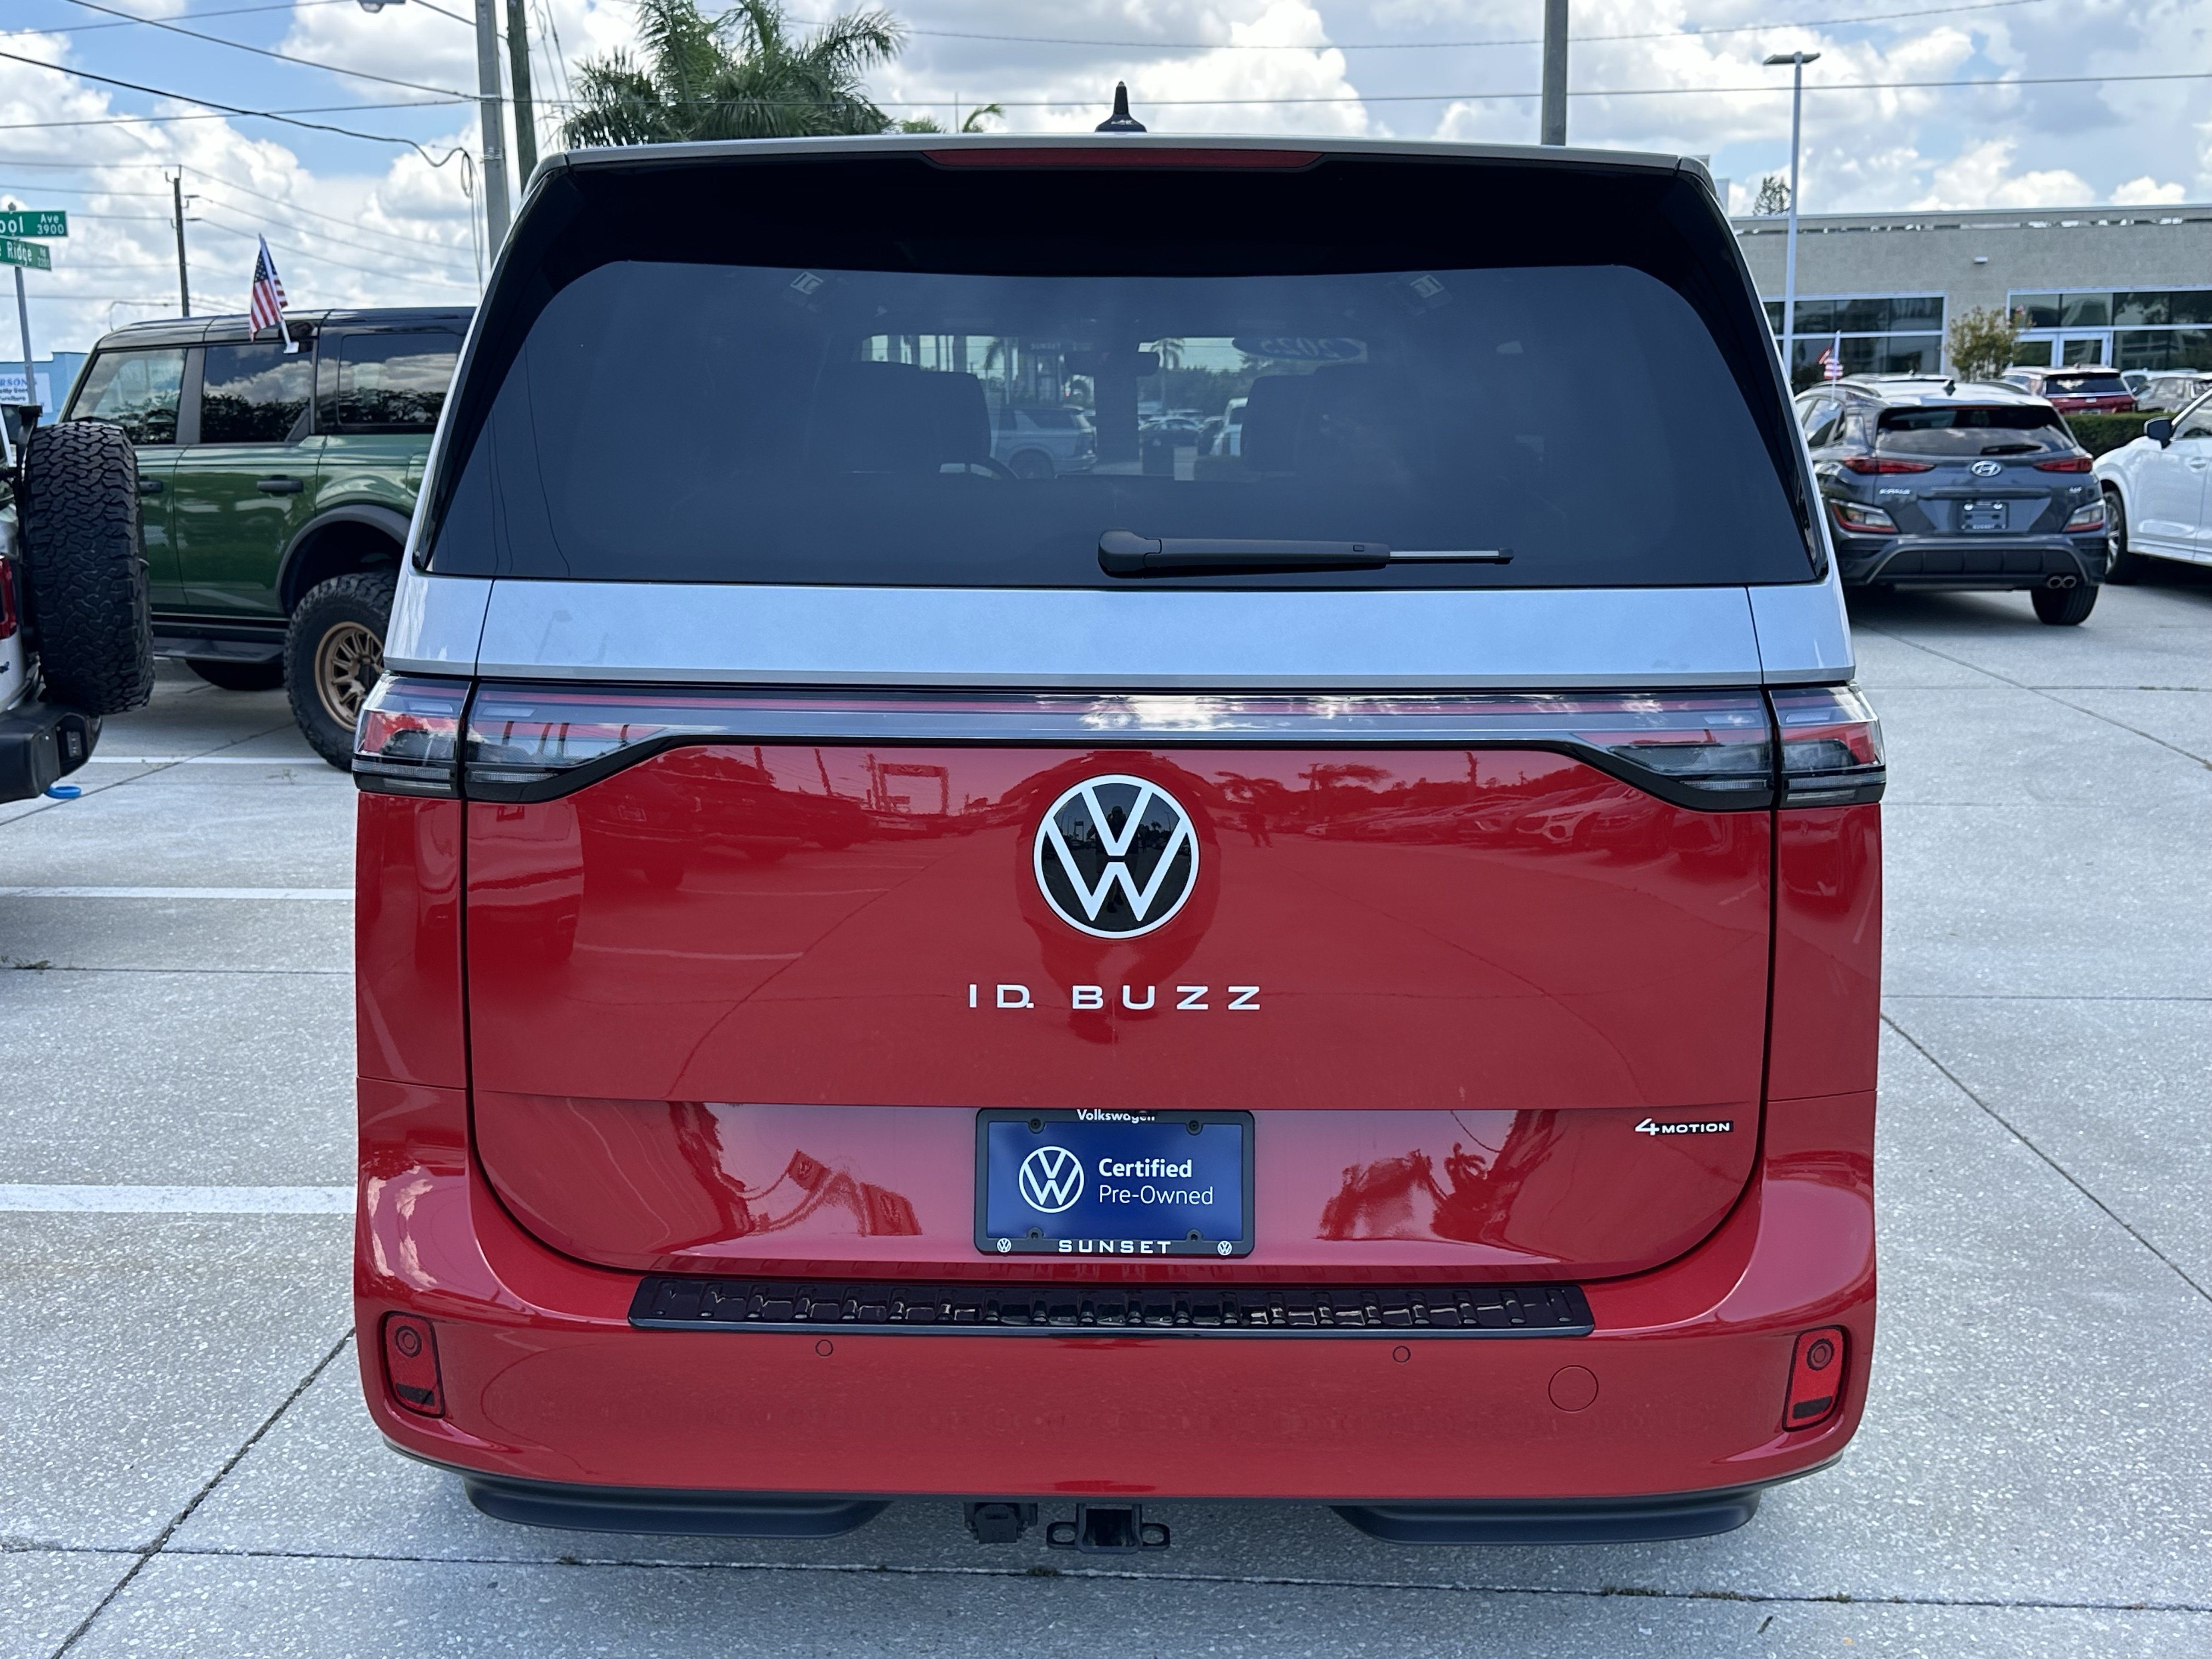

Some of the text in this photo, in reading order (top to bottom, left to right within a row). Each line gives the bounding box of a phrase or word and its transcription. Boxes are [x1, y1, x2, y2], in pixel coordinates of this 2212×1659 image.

[41, 213, 59, 223] Ave
[37, 224, 64, 235] 3900
[7, 241, 32, 266] Ridge
[1071, 985, 1260, 1010] BUZZ
[1635, 1118, 1730, 1136] 4MOTION
[1098, 1158, 1192, 1178] Certified
[1099, 1184, 1214, 1205] Pre-Owned
[1058, 1240, 1171, 1254] SUNSET
